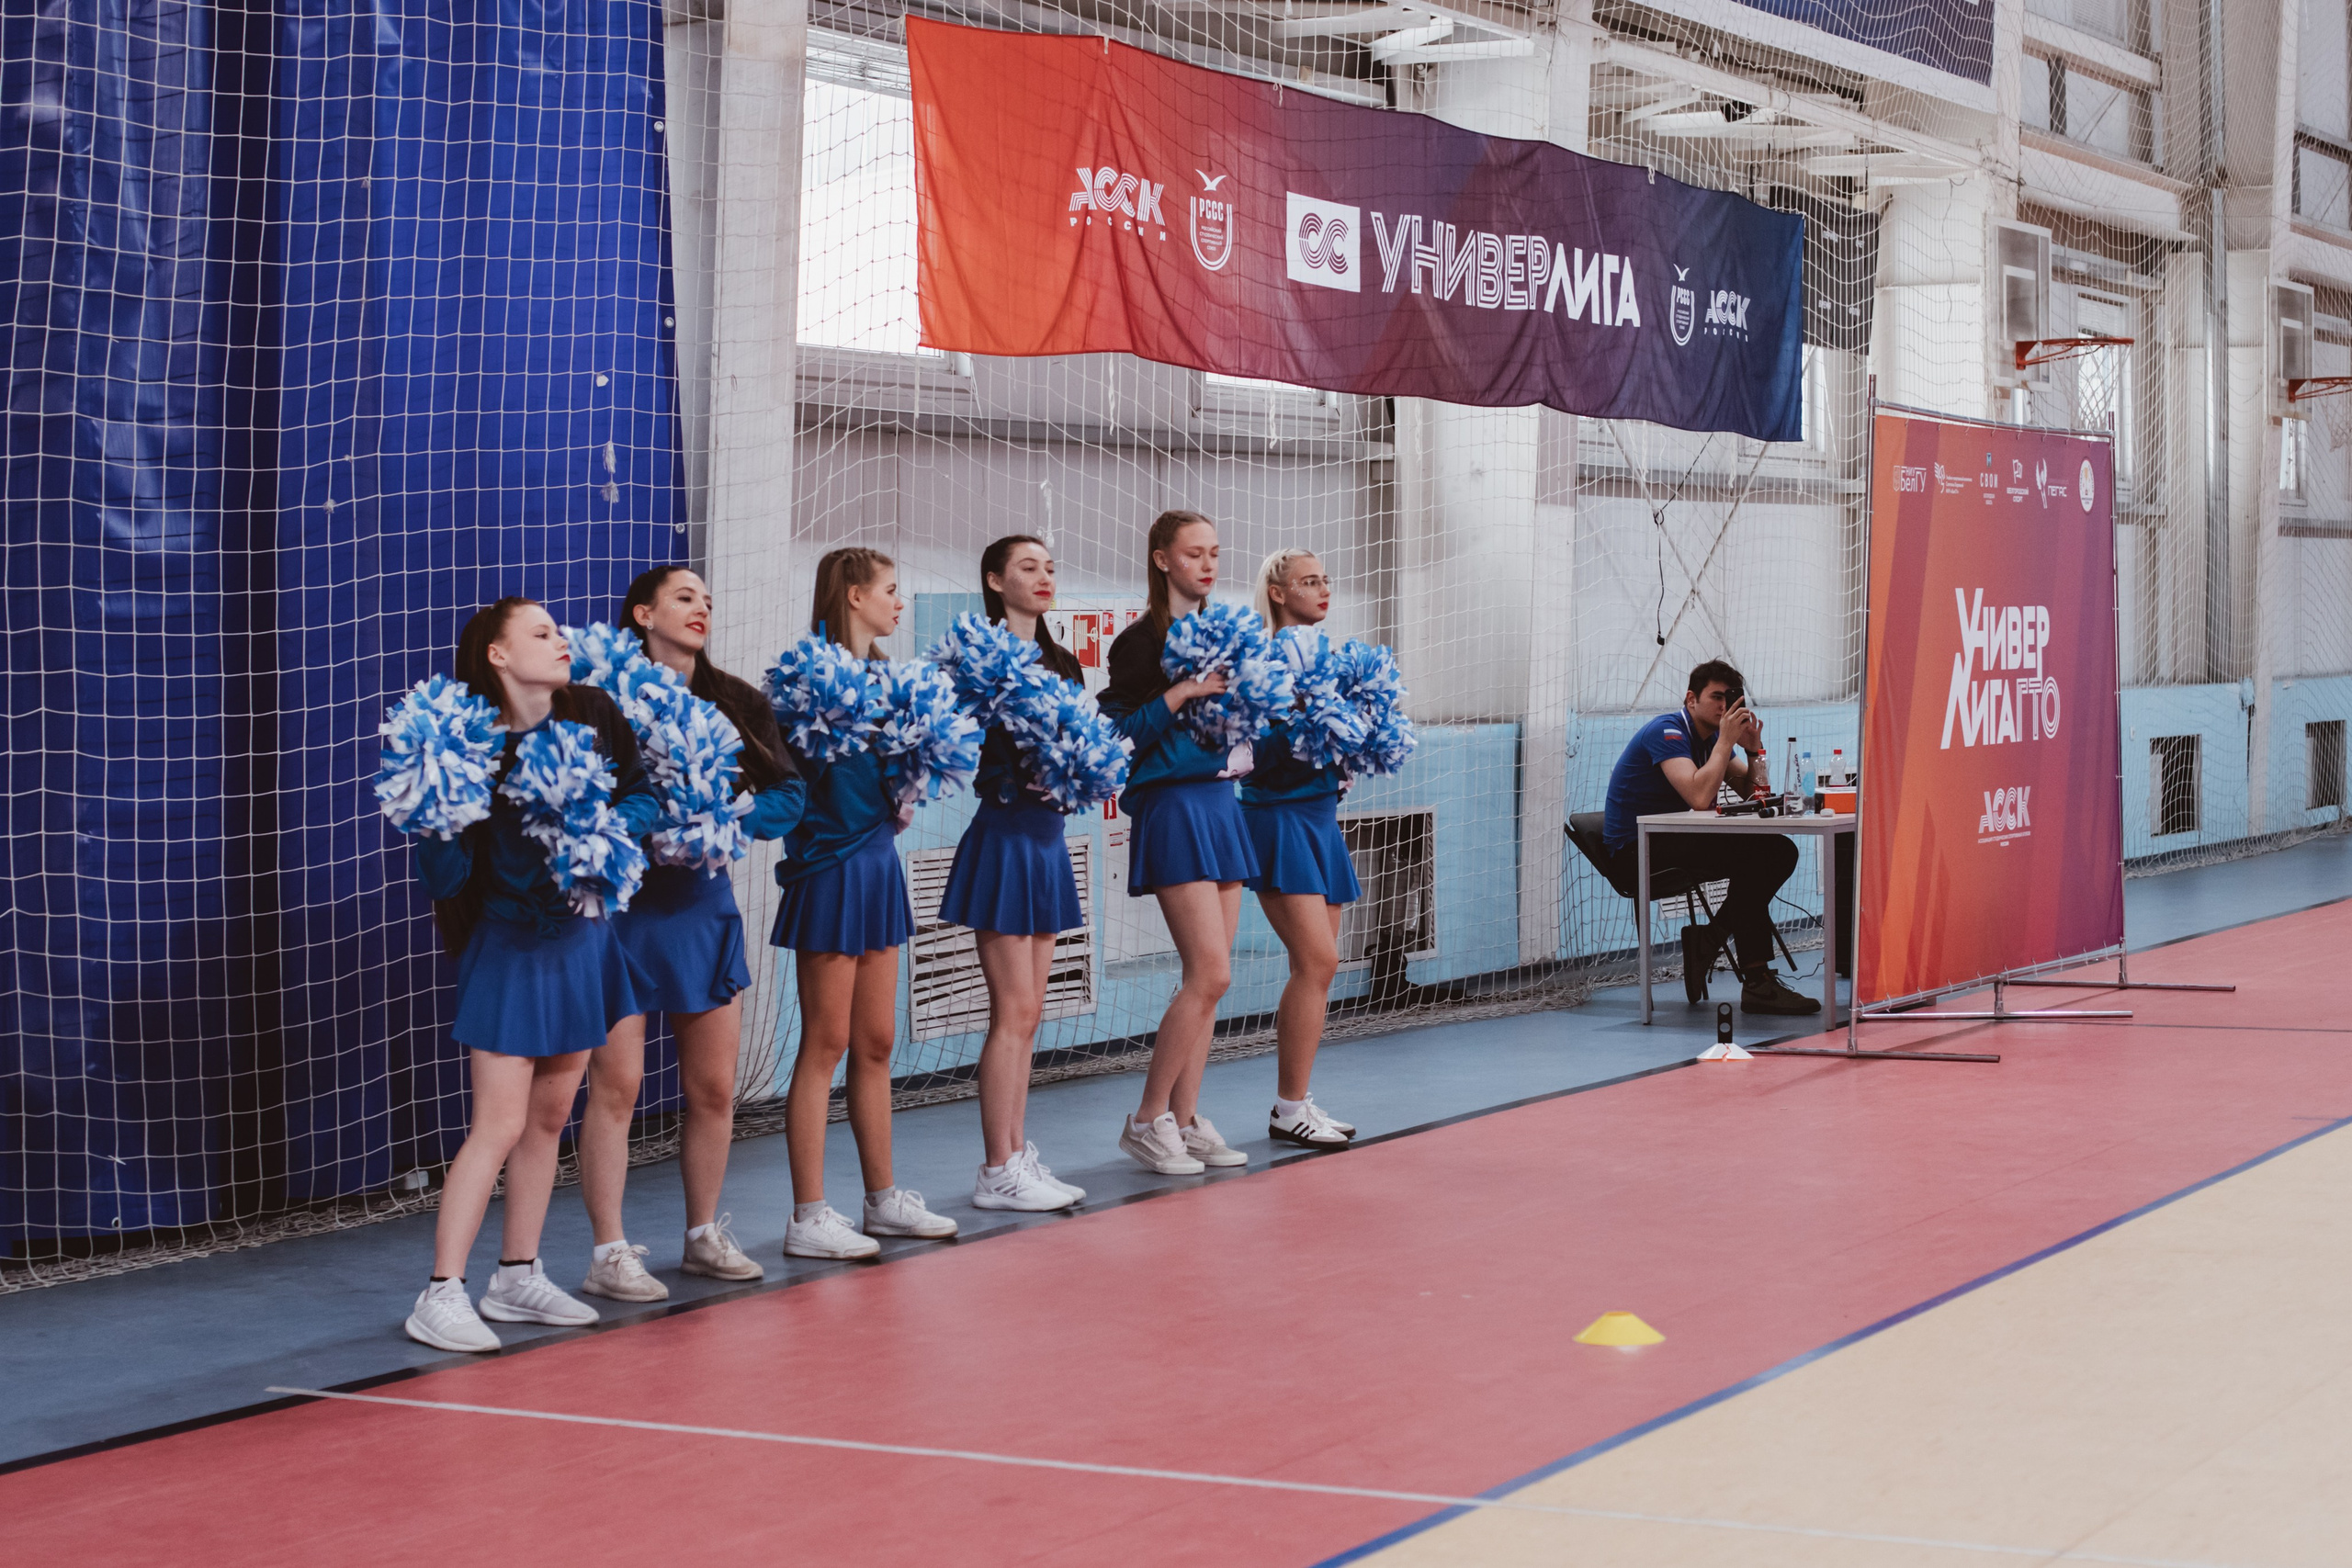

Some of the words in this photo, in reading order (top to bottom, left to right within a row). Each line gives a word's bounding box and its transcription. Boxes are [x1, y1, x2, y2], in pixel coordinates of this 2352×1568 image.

[1069, 166, 1166, 227] АССК
[1199, 197, 1224, 221] РССС
[1069, 216, 1166, 242] РОССИИ
[1370, 210, 1641, 328] УНИВЕРЛИГА
[1978, 785, 2031, 834] АССК
